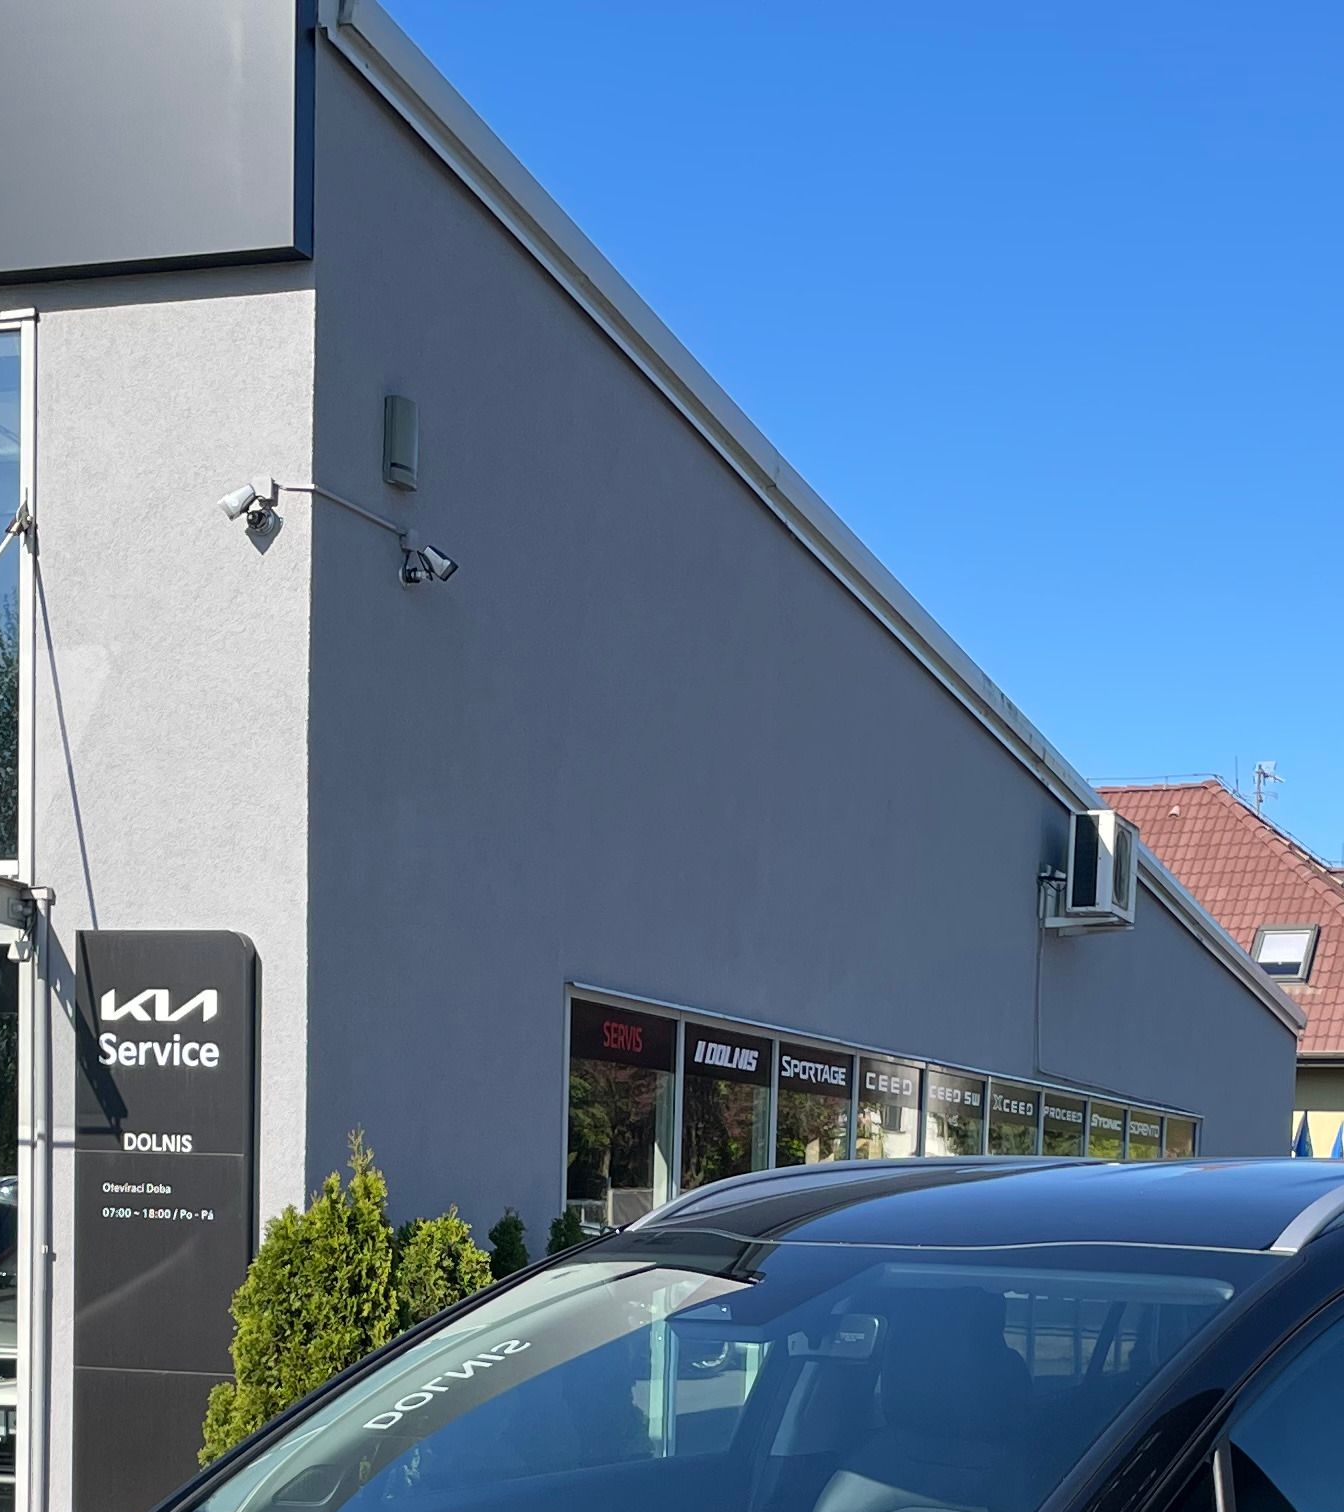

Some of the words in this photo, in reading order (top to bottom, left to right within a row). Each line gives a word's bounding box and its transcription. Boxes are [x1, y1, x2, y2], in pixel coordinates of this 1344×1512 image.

[100, 988, 218, 1022] KIA
[602, 1021, 643, 1053] SERVIS
[98, 1032, 220, 1068] Service
[706, 1040, 759, 1072] DOLNIS
[781, 1056, 847, 1086] SPORTAGE
[865, 1072, 912, 1096] CEED
[929, 1084, 960, 1103] CEED
[964, 1091, 981, 1107] SW
[992, 1093, 1034, 1117] XCEED
[1043, 1105, 1083, 1123] PROCEED
[123, 1132, 193, 1153] DOLNIS
[146, 1183, 172, 1195] Doba
[102, 1207, 132, 1218] 07:00
[143, 1208, 172, 1219] 18:00
[179, 1209, 193, 1220] Po
